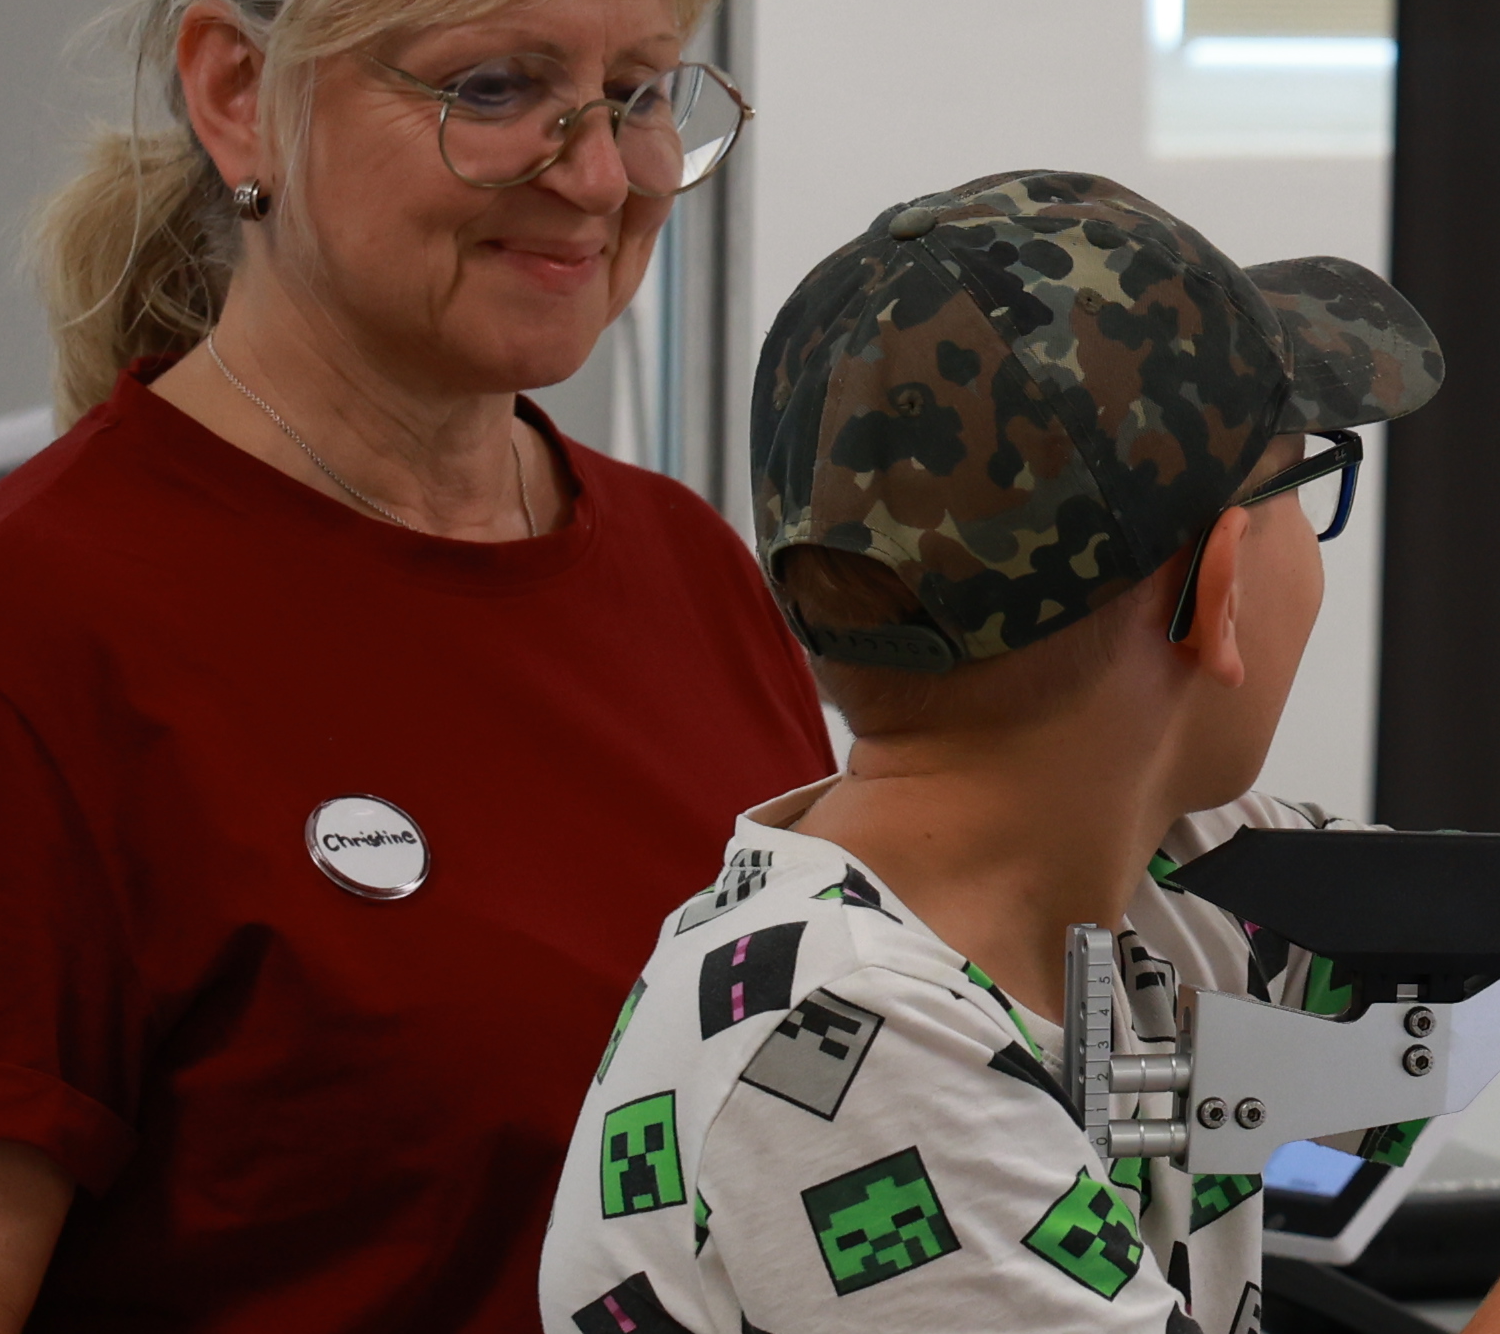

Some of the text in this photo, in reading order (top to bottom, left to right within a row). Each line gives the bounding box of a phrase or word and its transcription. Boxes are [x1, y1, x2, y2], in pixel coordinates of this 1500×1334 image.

[322, 830, 417, 852] Christine
[1100, 976, 1111, 985] 5
[1099, 1008, 1110, 1017] 4
[1098, 1040, 1109, 1049] 3
[1098, 1073, 1109, 1081] 2
[1096, 1137, 1107, 1145] 0
